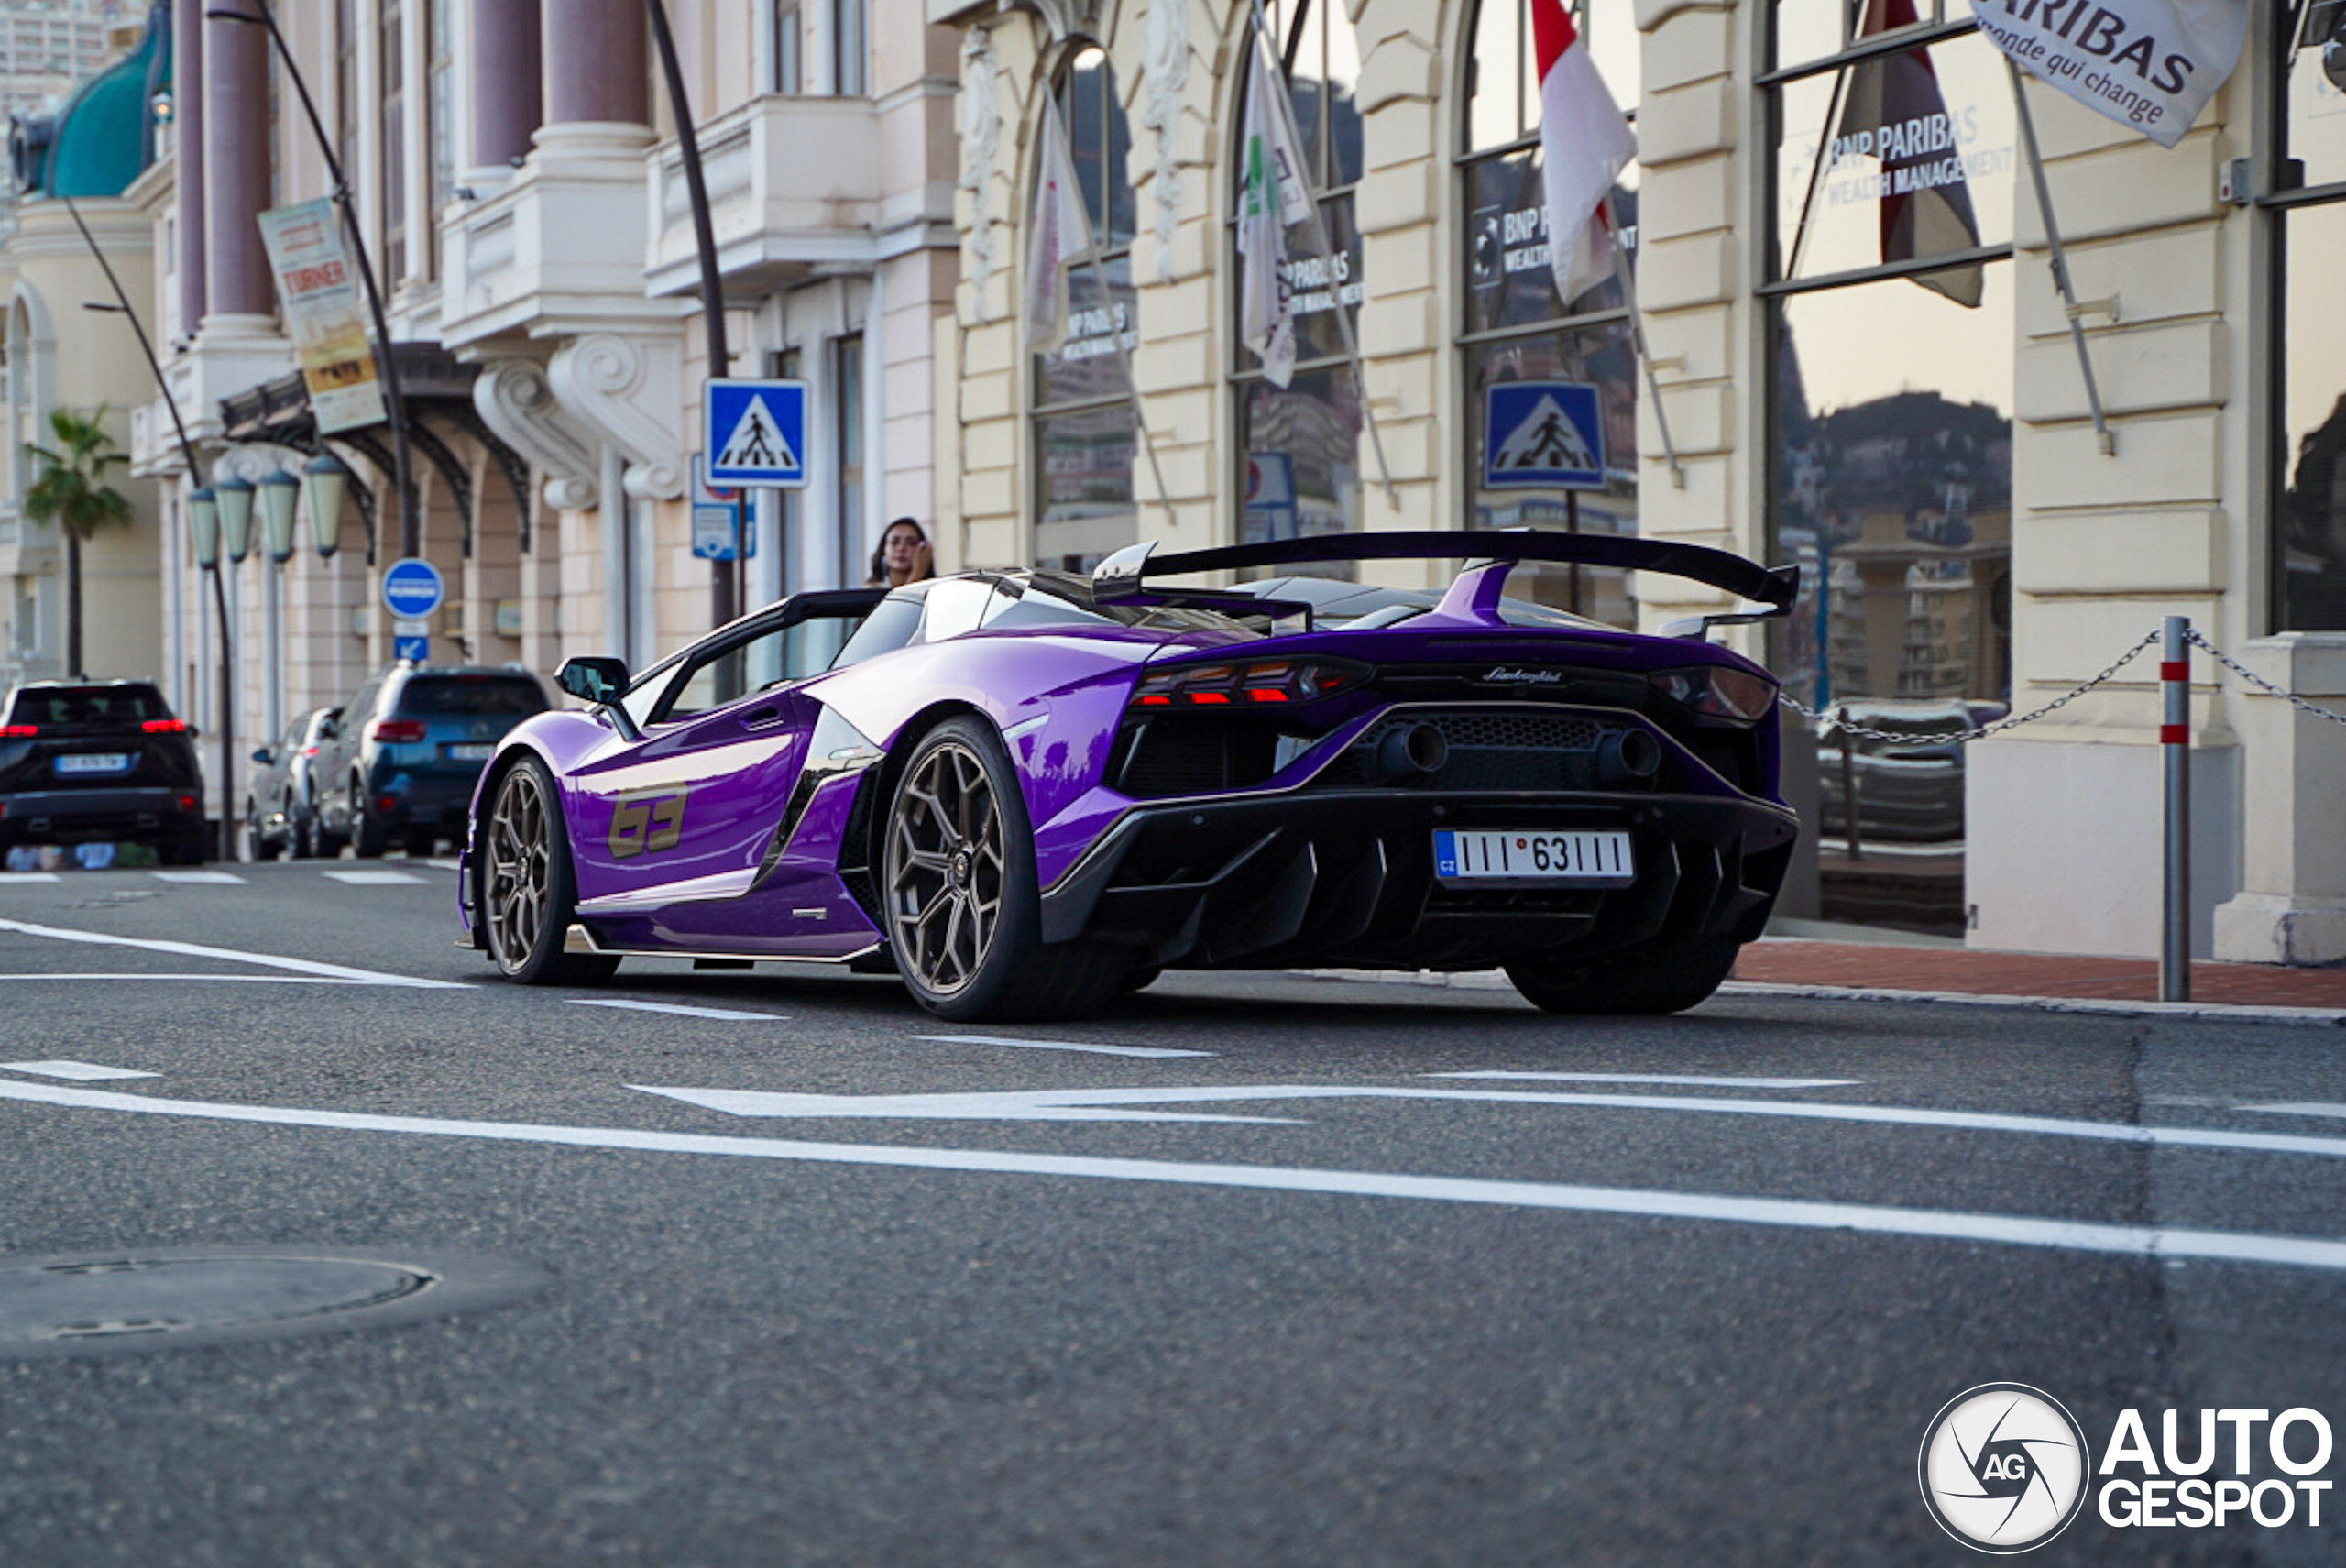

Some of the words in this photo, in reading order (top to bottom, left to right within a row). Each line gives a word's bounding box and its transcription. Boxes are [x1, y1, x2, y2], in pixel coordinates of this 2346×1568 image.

[2047, 54, 2086, 80] qui
[2084, 71, 2164, 124] change
[1829, 129, 1874, 172] BNP
[1877, 104, 1978, 162] PARIBAS
[1827, 170, 1891, 205] WEALTH
[1893, 145, 2013, 194] MANAGEMENT
[1504, 208, 1538, 246] BNP
[282, 259, 347, 296] TURNER
[607, 781, 688, 861] 63
[1440, 860, 1455, 872] CZ
